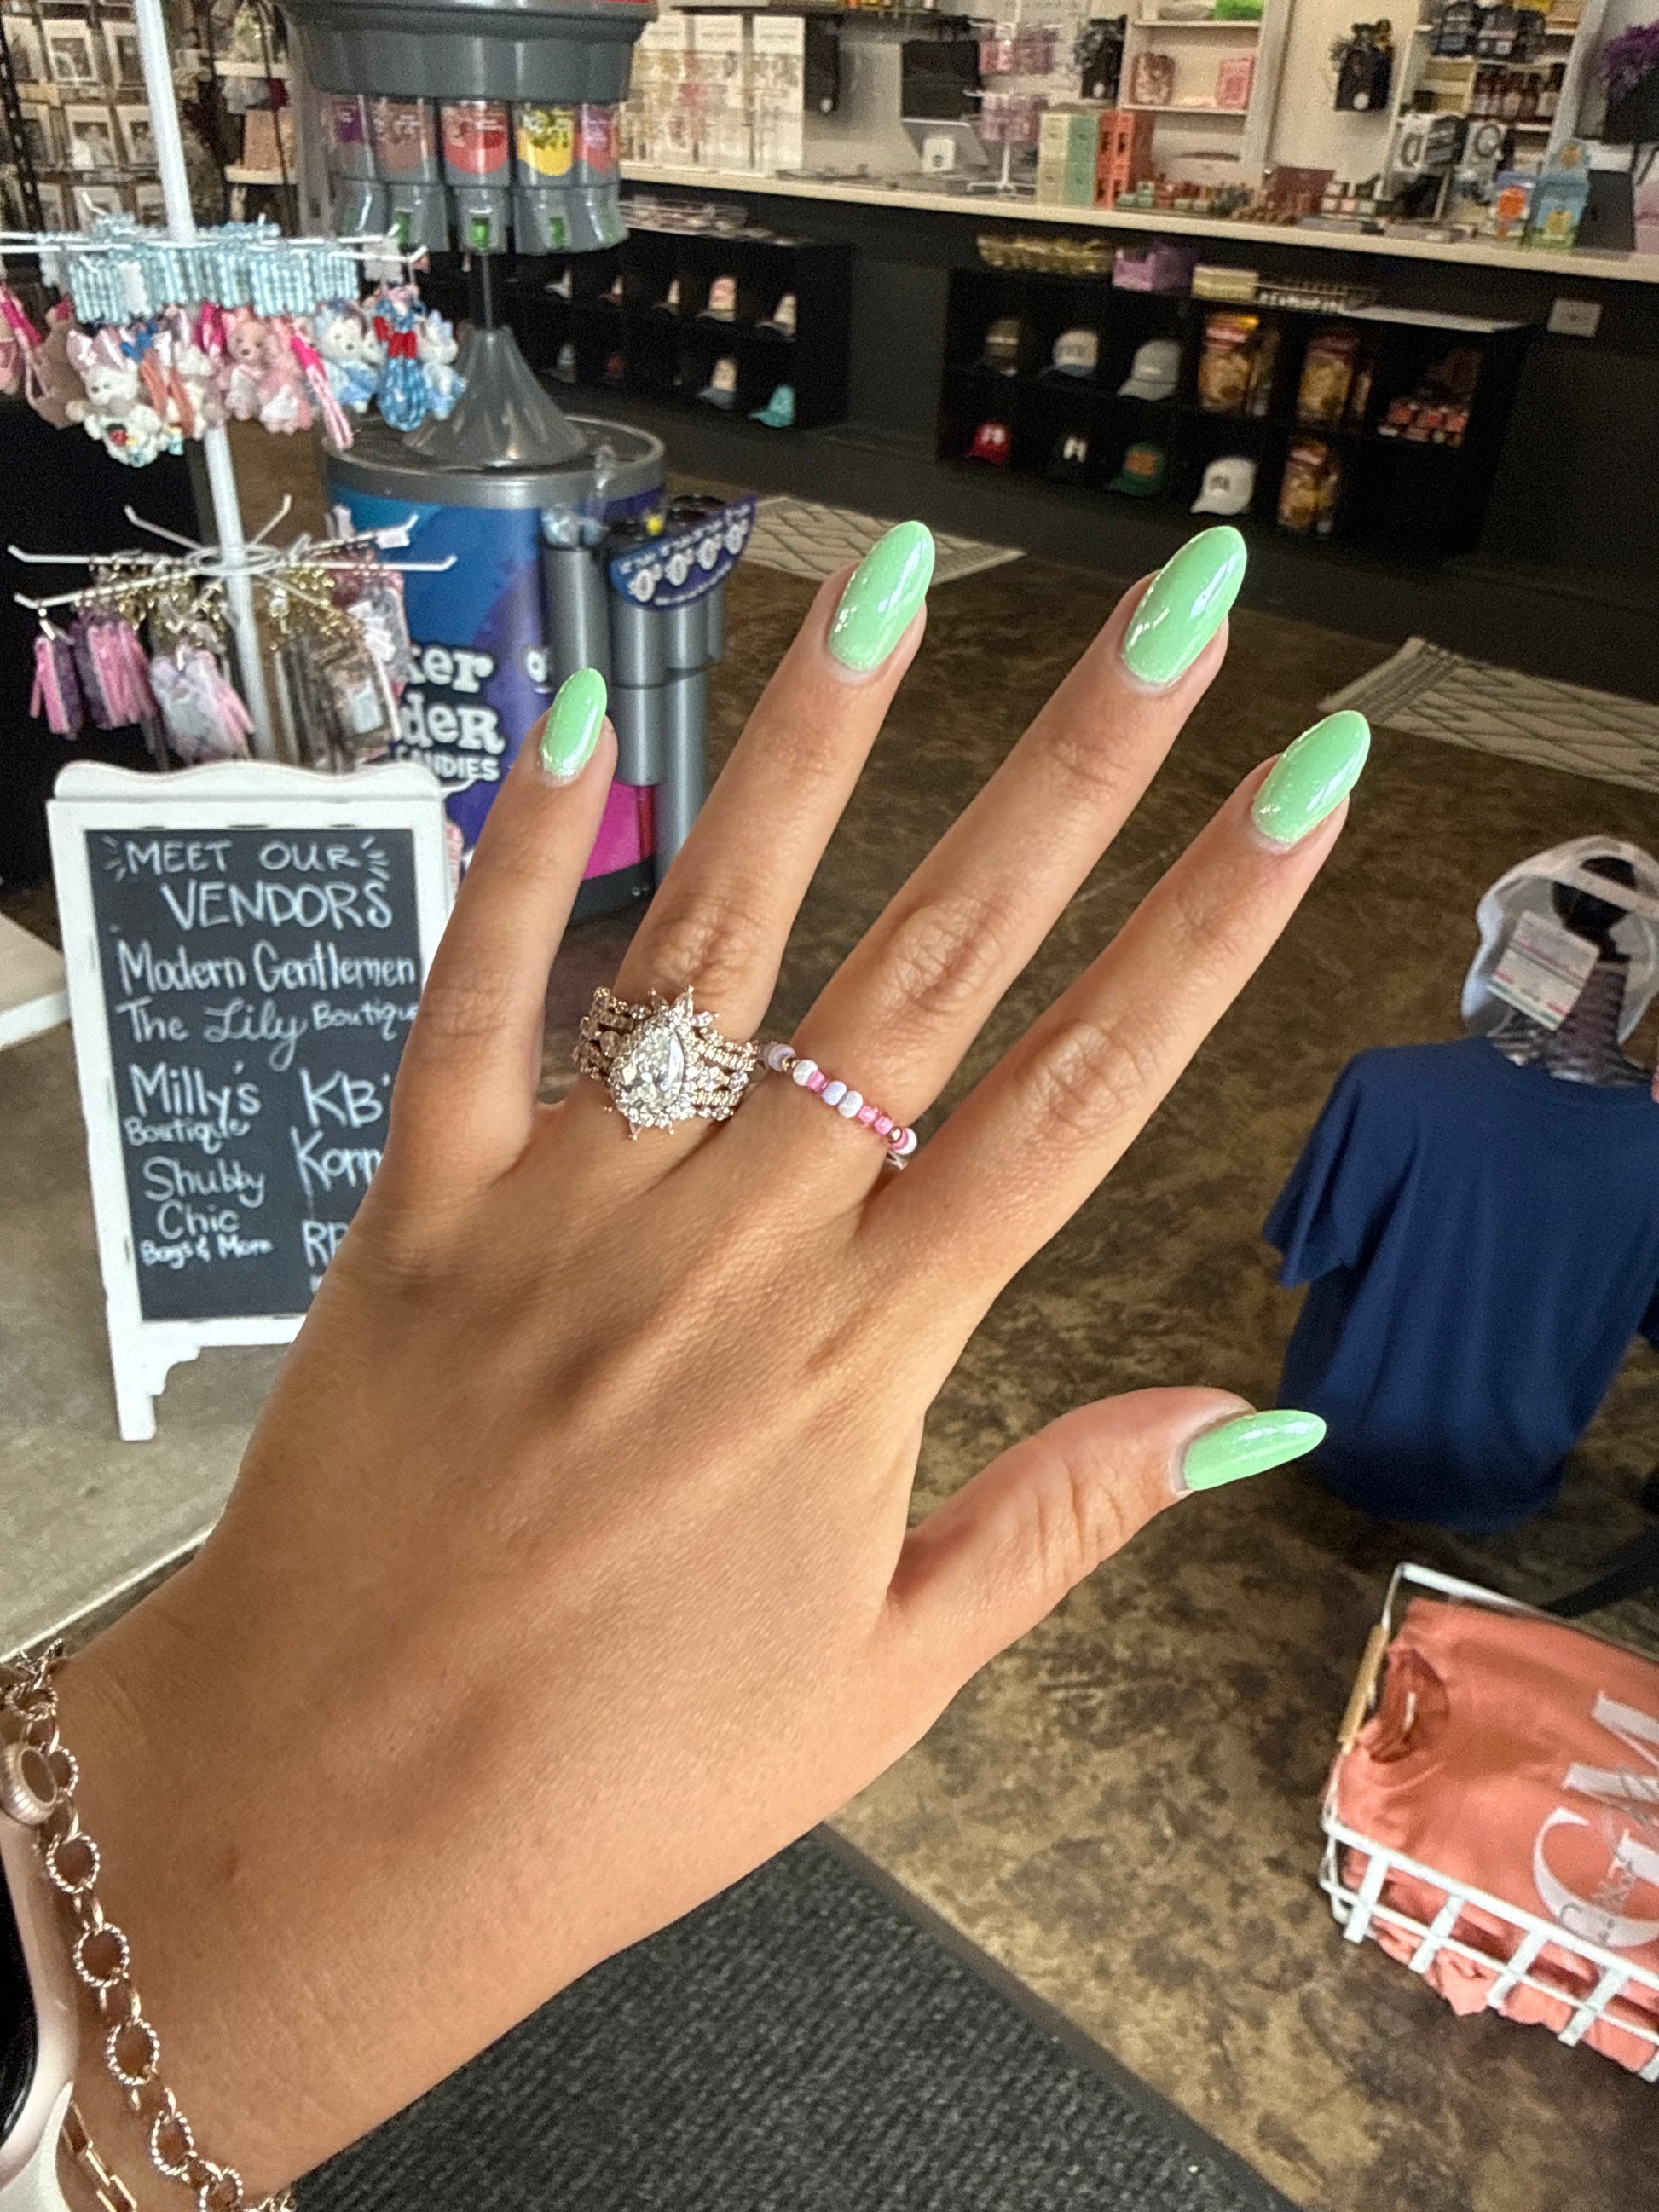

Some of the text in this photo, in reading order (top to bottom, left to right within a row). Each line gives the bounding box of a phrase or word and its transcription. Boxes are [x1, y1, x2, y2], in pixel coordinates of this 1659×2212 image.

[125, 840, 361, 875] MEET OUR
[160, 879, 392, 931] VENDORS
[116, 939, 415, 996] Modern Gentlemen
[114, 996, 188, 1042] The
[202, 996, 309, 1072] Lily
[130, 1060, 262, 1139] Milly's
[124, 1115, 251, 1154] Boutique
[157, 1198, 240, 1240] Chic
